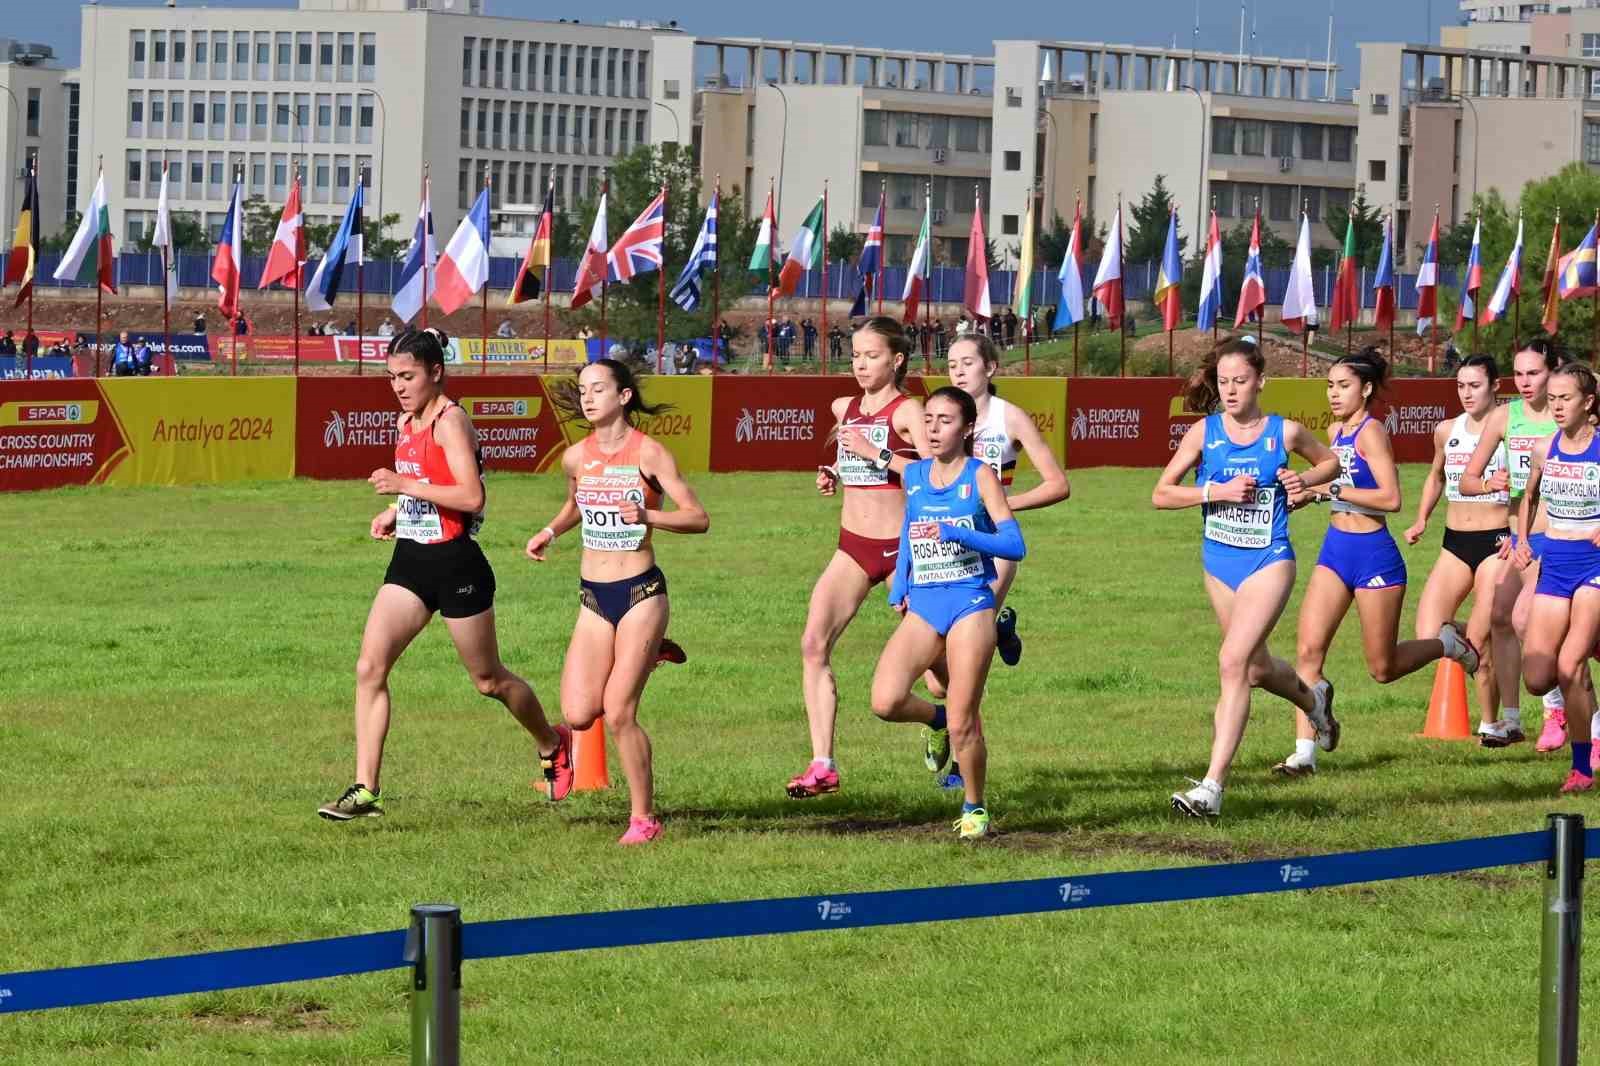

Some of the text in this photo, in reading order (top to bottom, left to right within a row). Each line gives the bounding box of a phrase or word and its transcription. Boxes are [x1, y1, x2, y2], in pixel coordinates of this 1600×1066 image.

[28, 407, 66, 419] SPAR
[481, 403, 513, 414] SPAR
[755, 408, 815, 424] EUROPEAN
[1088, 408, 1140, 424] EUROPEAN
[1399, 406, 1446, 420] EUROPEAN
[347, 411, 398, 427] EUROPE
[653, 415, 692, 436] 2024
[1399, 420, 1438, 434] ATHLETIC
[152, 415, 272, 448] Antalya 2024
[347, 429, 398, 445] ATHLETI
[490, 427, 538, 441] COUNTRY
[755, 425, 814, 441] ATHLETICS
[1088, 424, 1139, 439] ATHLETICS
[0, 433, 96, 449] CROSS COUNTRY
[481, 445, 537, 458] PIONSHIPS
[0, 452, 94, 469] CHAMPIONSHIPS
[1223, 467, 1261, 477] ITALIA
[1544, 463, 1584, 478] SPAR
[1209, 502, 1271, 525] MUNARETTO
[1209, 530, 1267, 546] ANTALYA 2024
[913, 542, 939, 560] ROSA
